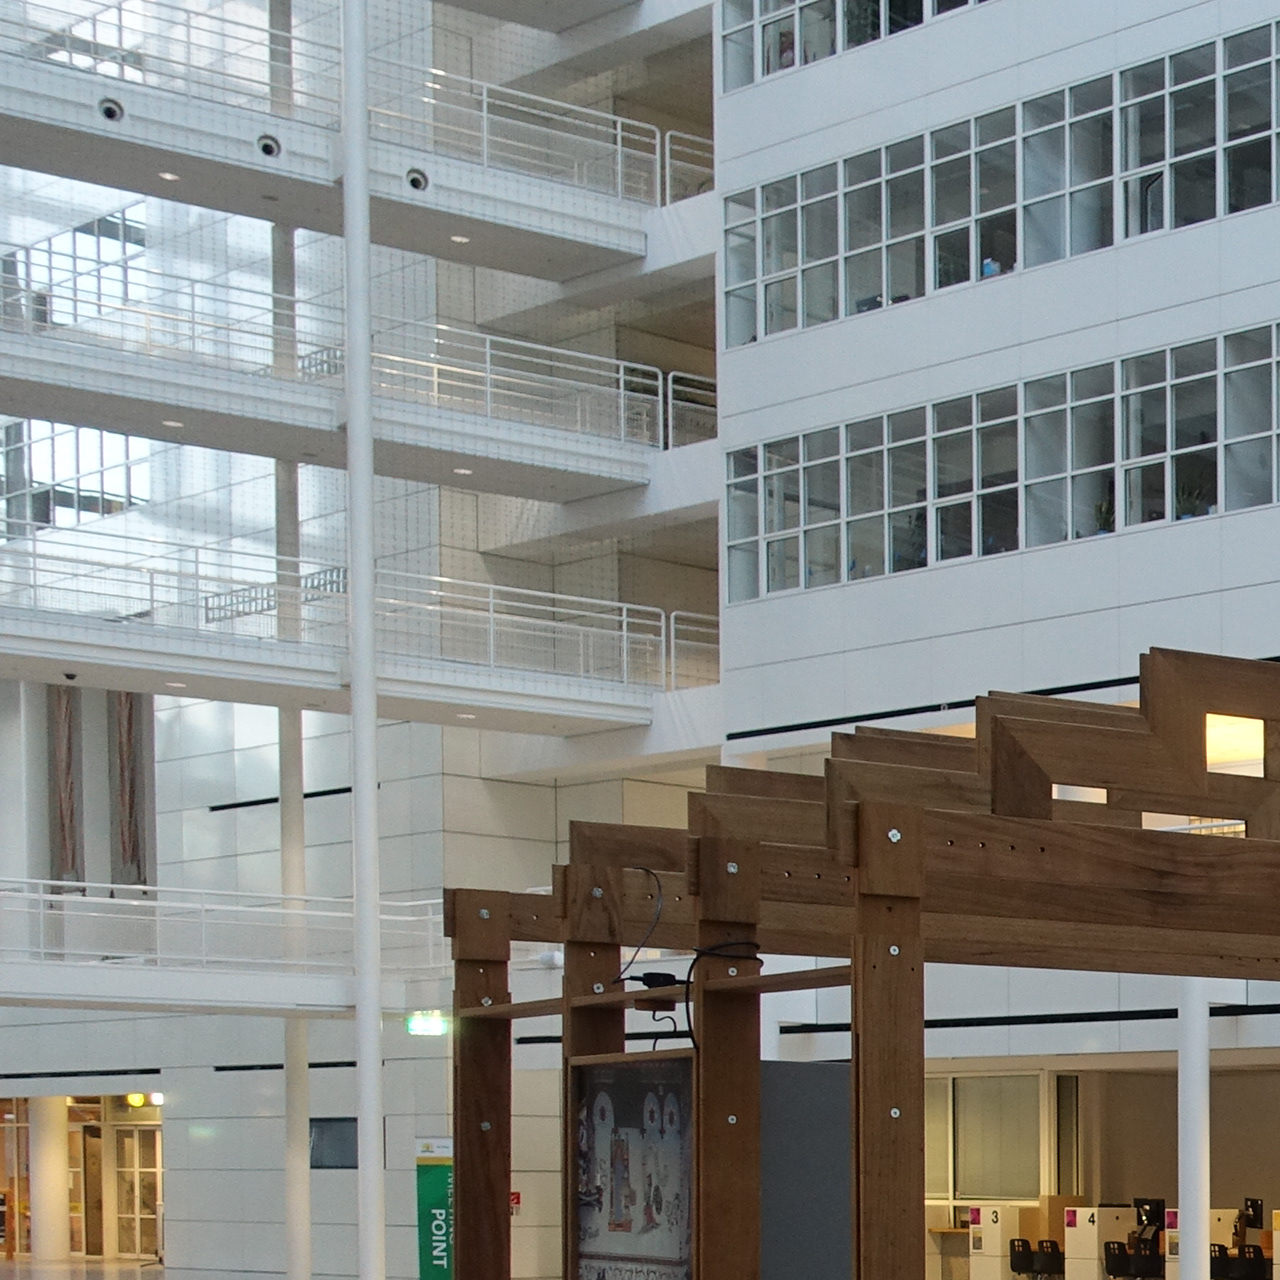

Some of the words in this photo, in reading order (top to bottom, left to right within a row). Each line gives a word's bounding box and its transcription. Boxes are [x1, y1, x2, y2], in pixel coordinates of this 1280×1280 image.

[992, 1211, 998, 1223] 3
[1088, 1212, 1096, 1226] 4
[431, 1209, 447, 1268] POINT
